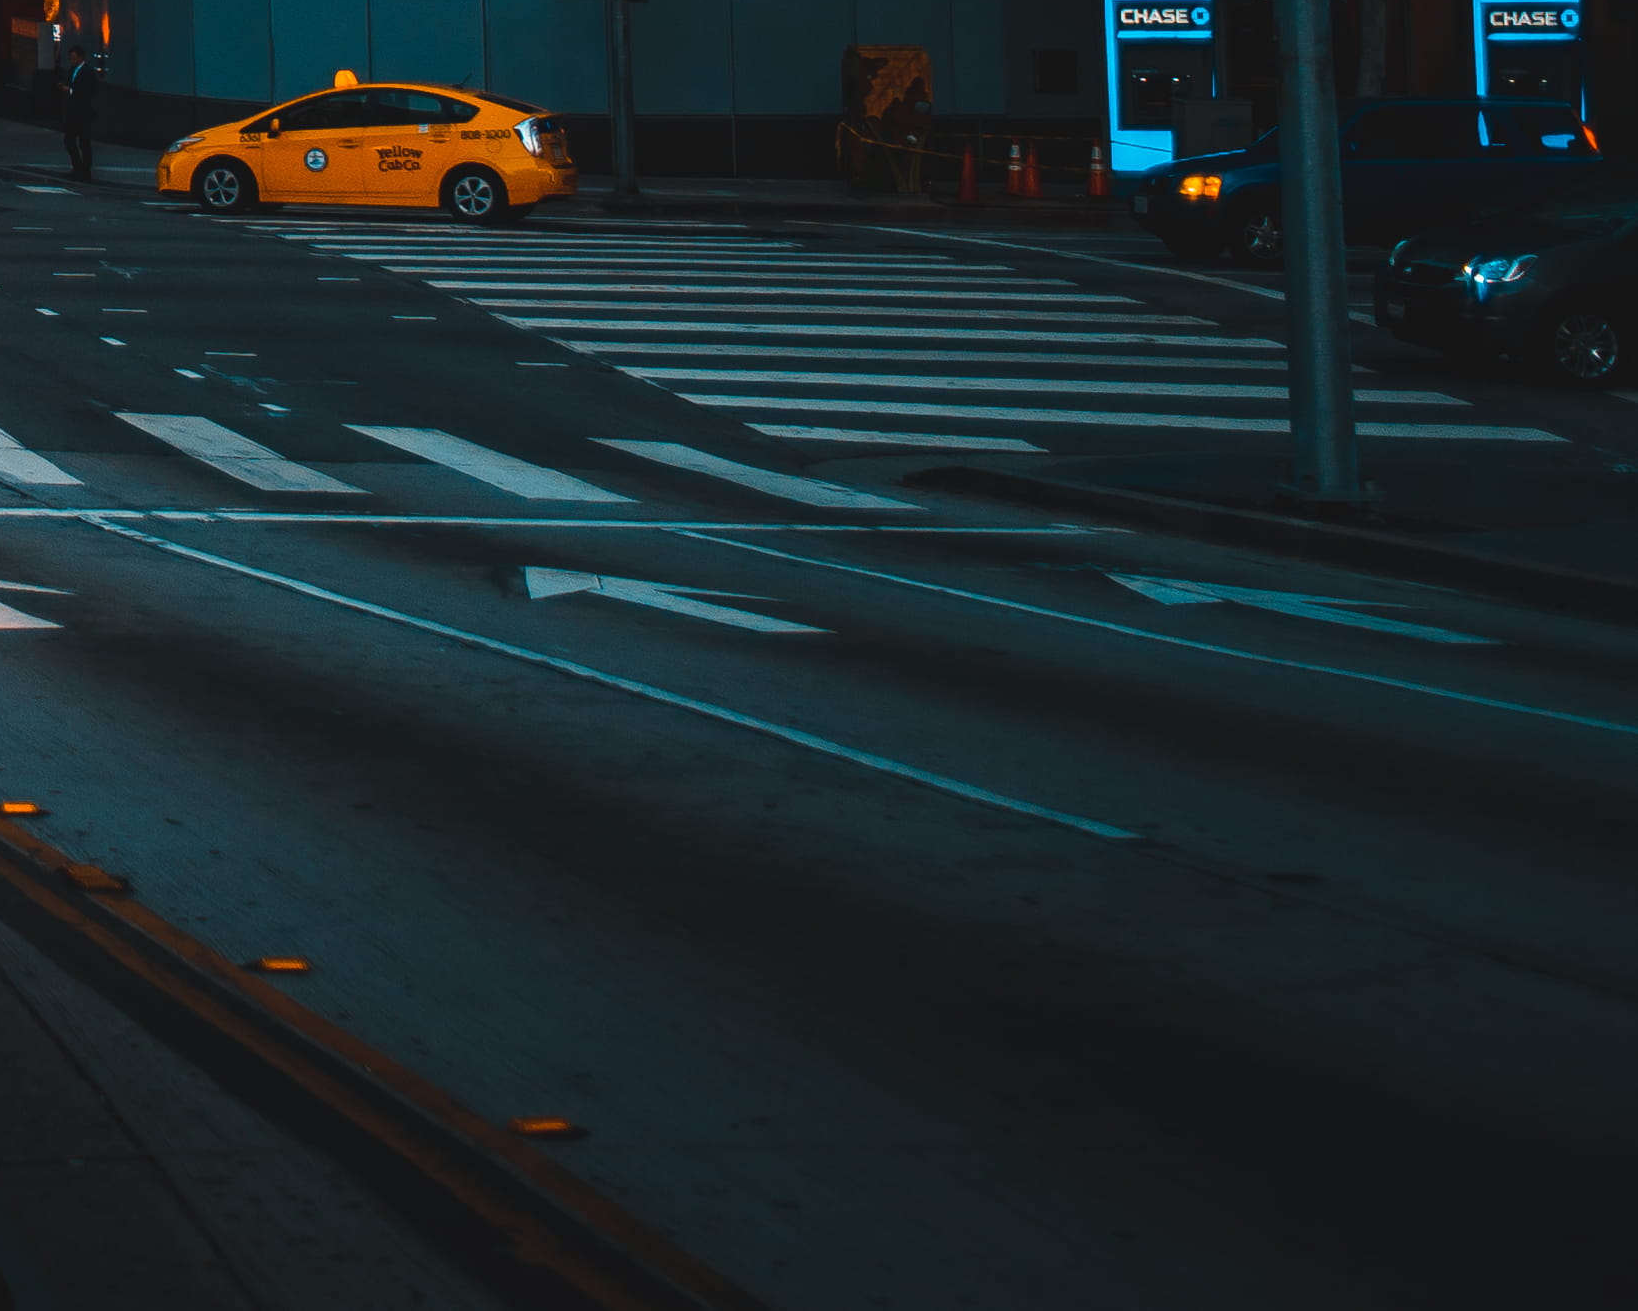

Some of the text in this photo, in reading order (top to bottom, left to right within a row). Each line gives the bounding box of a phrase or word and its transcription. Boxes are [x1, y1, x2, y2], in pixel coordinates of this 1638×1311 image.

[1120, 8, 1190, 25] CHASE
[1490, 11, 1559, 27] CHASE
[376, 145, 423, 159] Yellow
